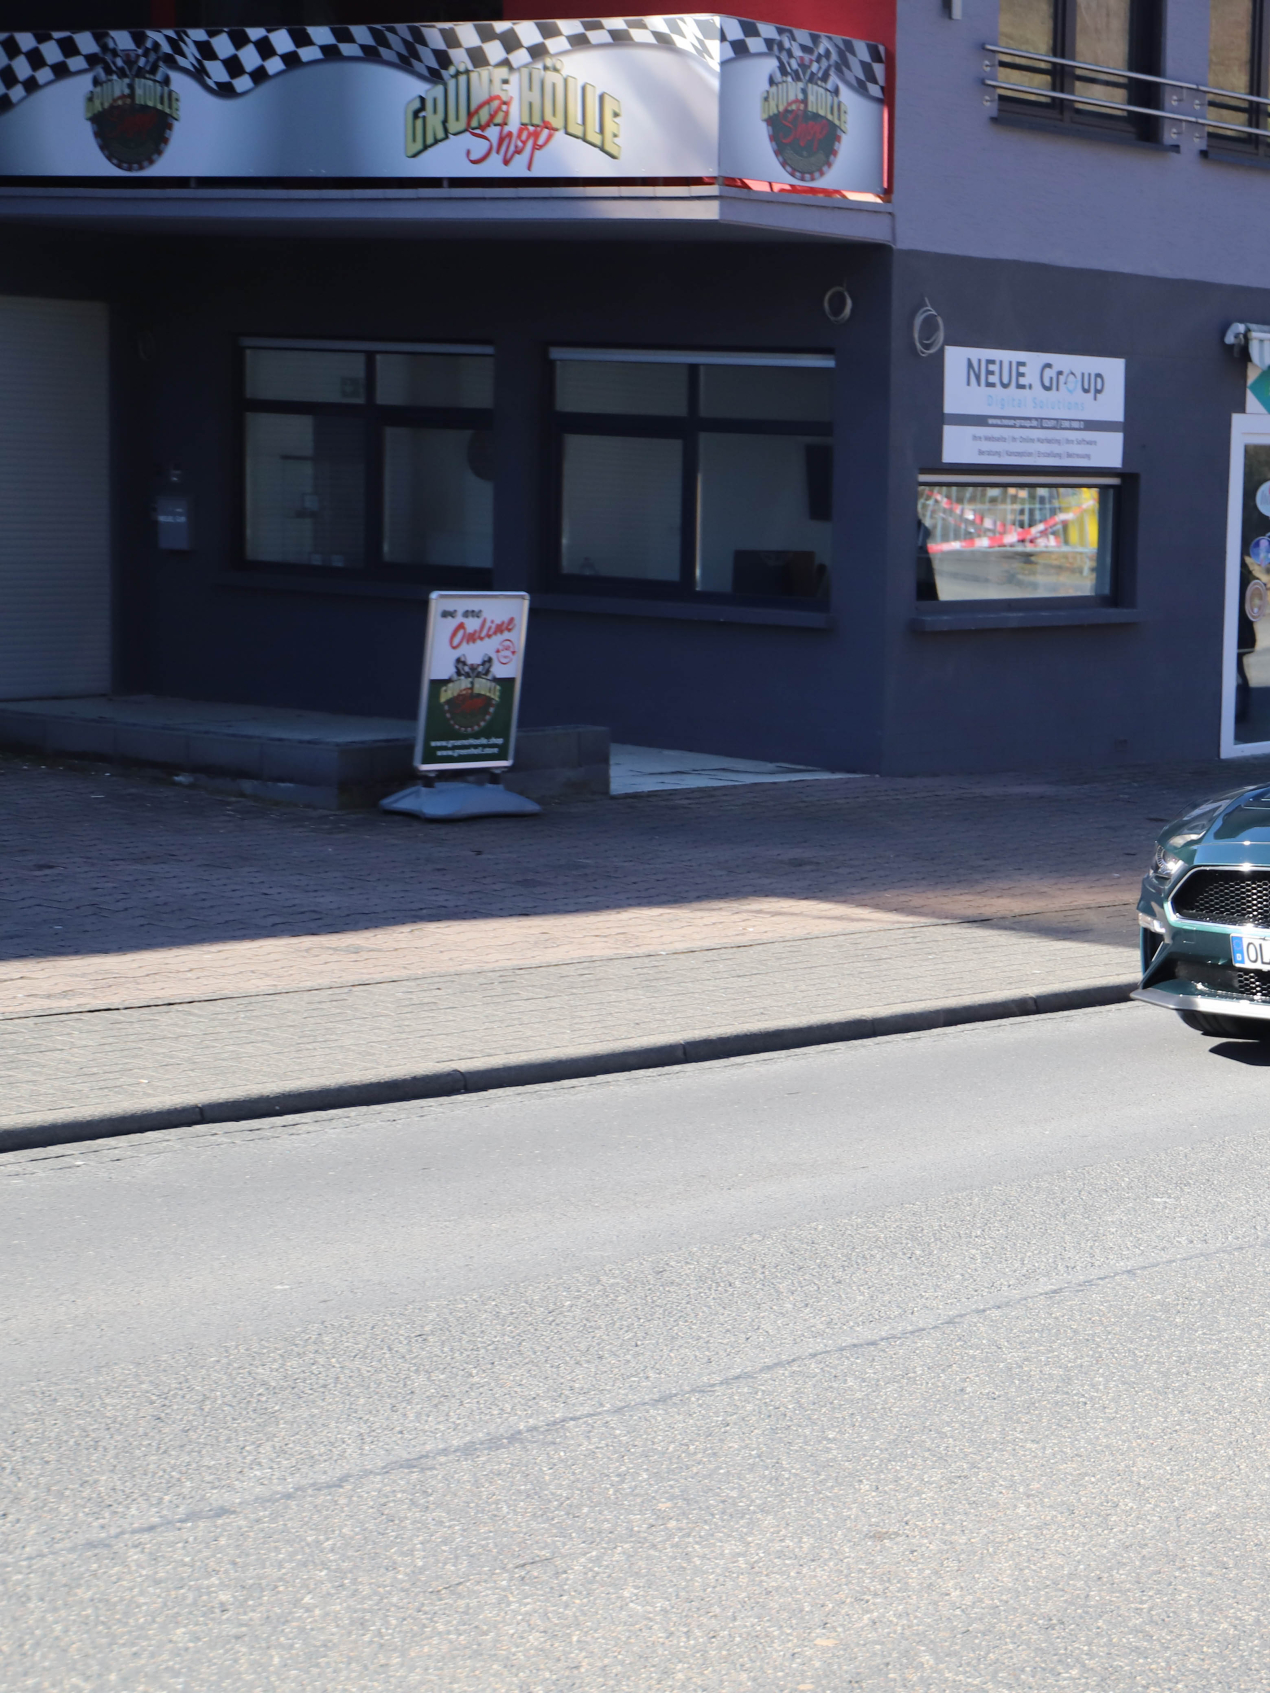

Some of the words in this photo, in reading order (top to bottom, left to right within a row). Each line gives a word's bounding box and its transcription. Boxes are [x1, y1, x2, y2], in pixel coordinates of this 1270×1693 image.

[405, 61, 510, 158] GRÜNE
[519, 57, 622, 160] HÖLLE
[466, 94, 556, 172] Shop
[779, 98, 829, 152] Shop
[807, 79, 848, 134] HÖLLE
[966, 357, 1033, 390] NEUE.
[1040, 362, 1105, 401] Group
[986, 394, 1027, 410] Digital
[1032, 397, 1085, 411] Solutions
[449, 616, 516, 650] Online
